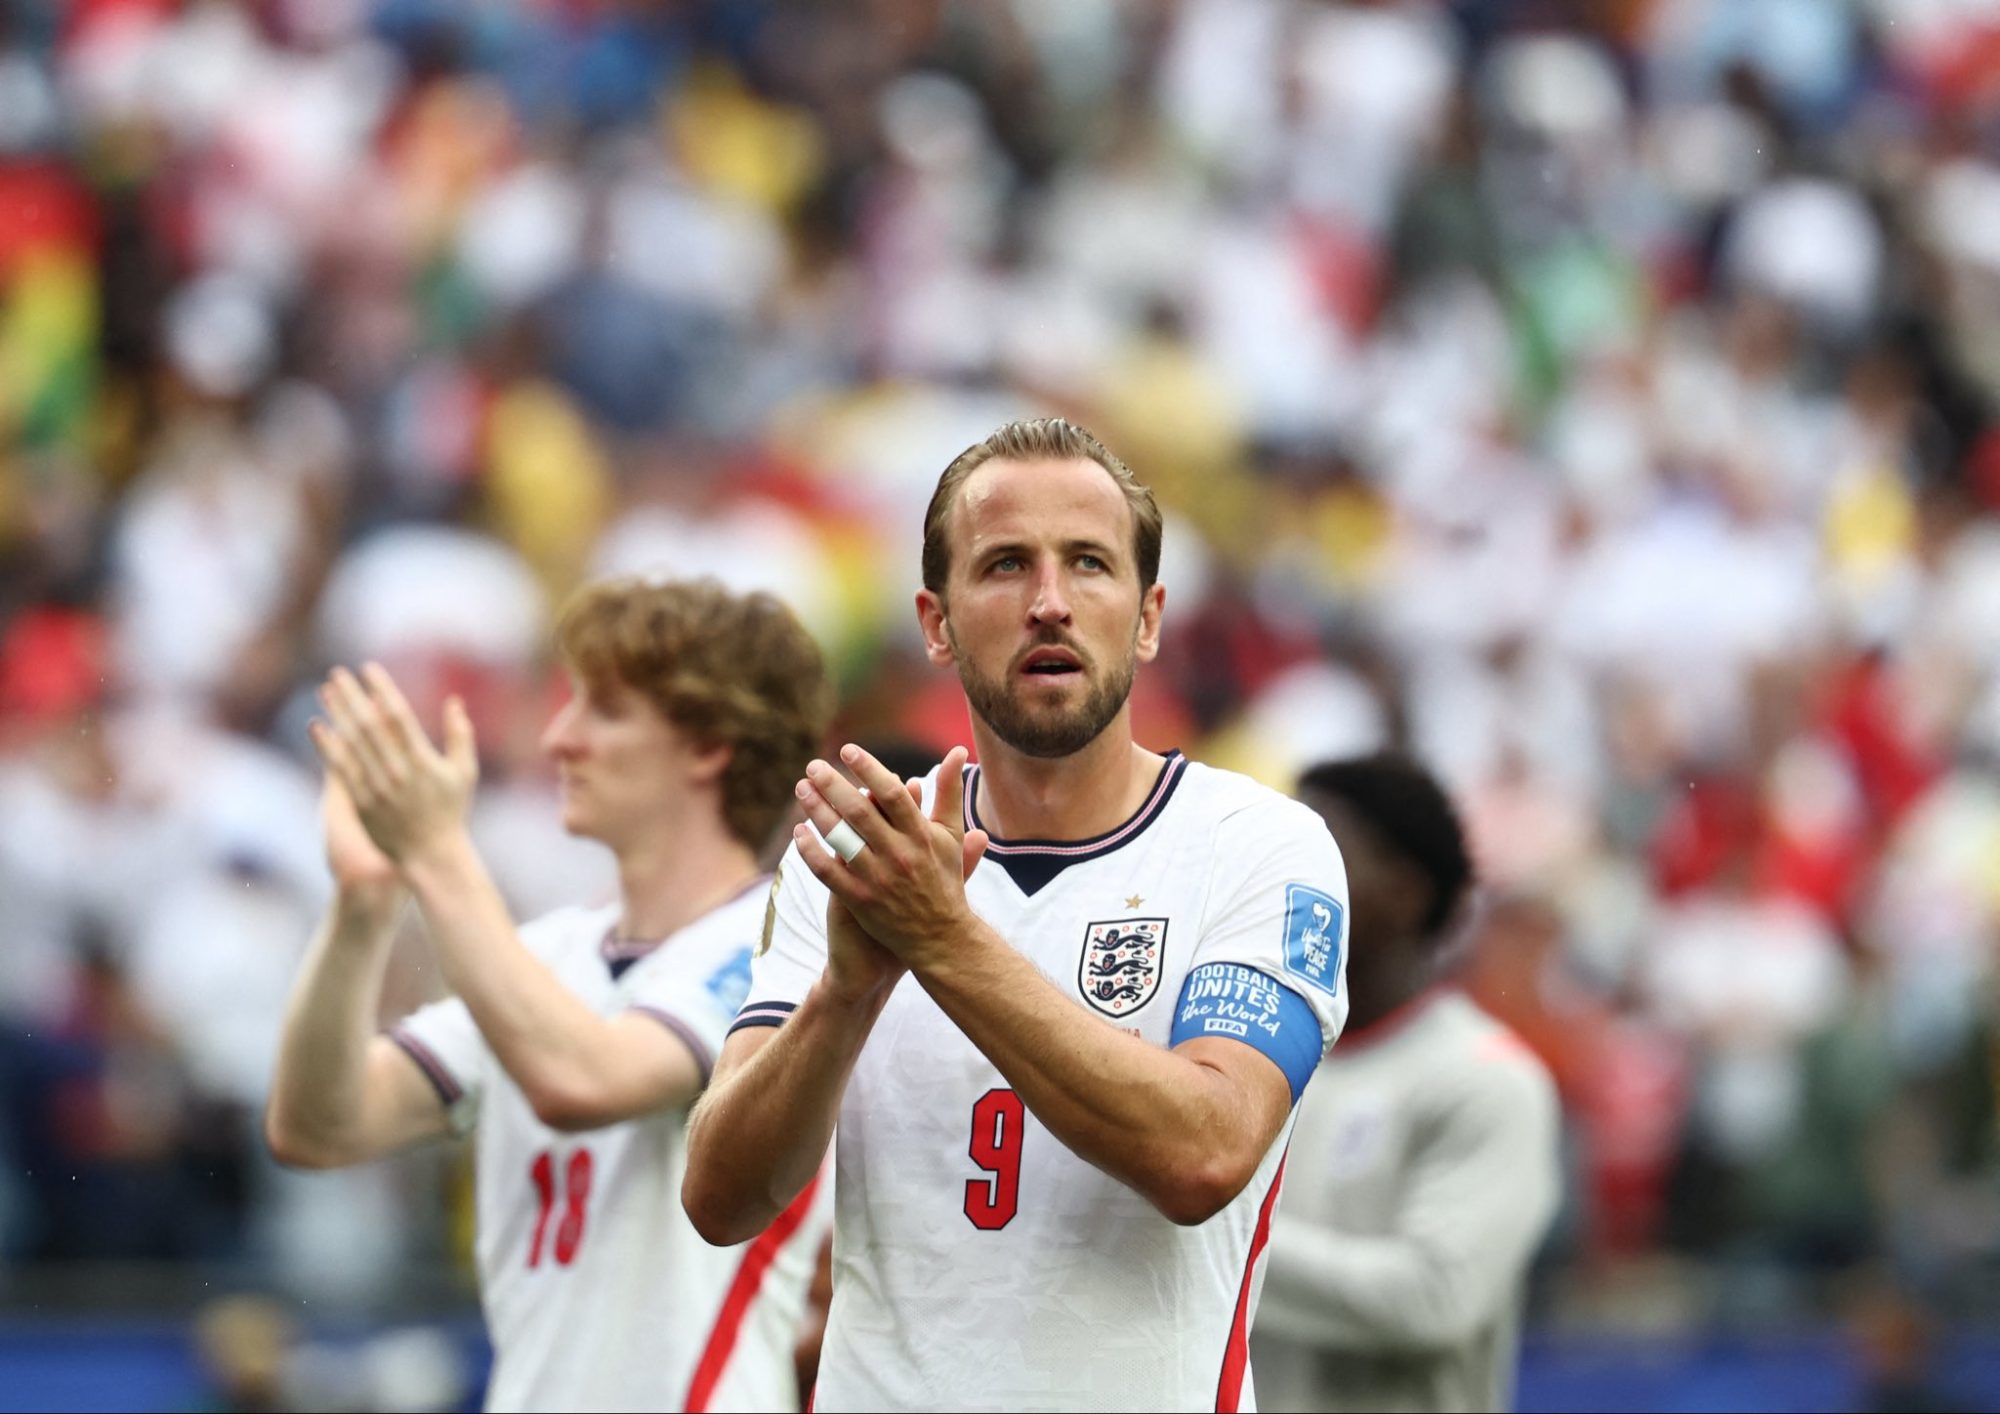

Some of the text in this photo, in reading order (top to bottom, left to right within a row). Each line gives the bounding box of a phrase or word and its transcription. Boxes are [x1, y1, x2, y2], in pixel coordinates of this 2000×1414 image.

[1187, 978, 1280, 1015] UNITES
[1192, 964, 1281, 998] FOOTBALL
[1181, 999, 1281, 1037] the World
[1208, 1021, 1244, 1033] FIFA
[964, 1088, 1025, 1230] 9
[527, 1148, 593, 1269] 18
